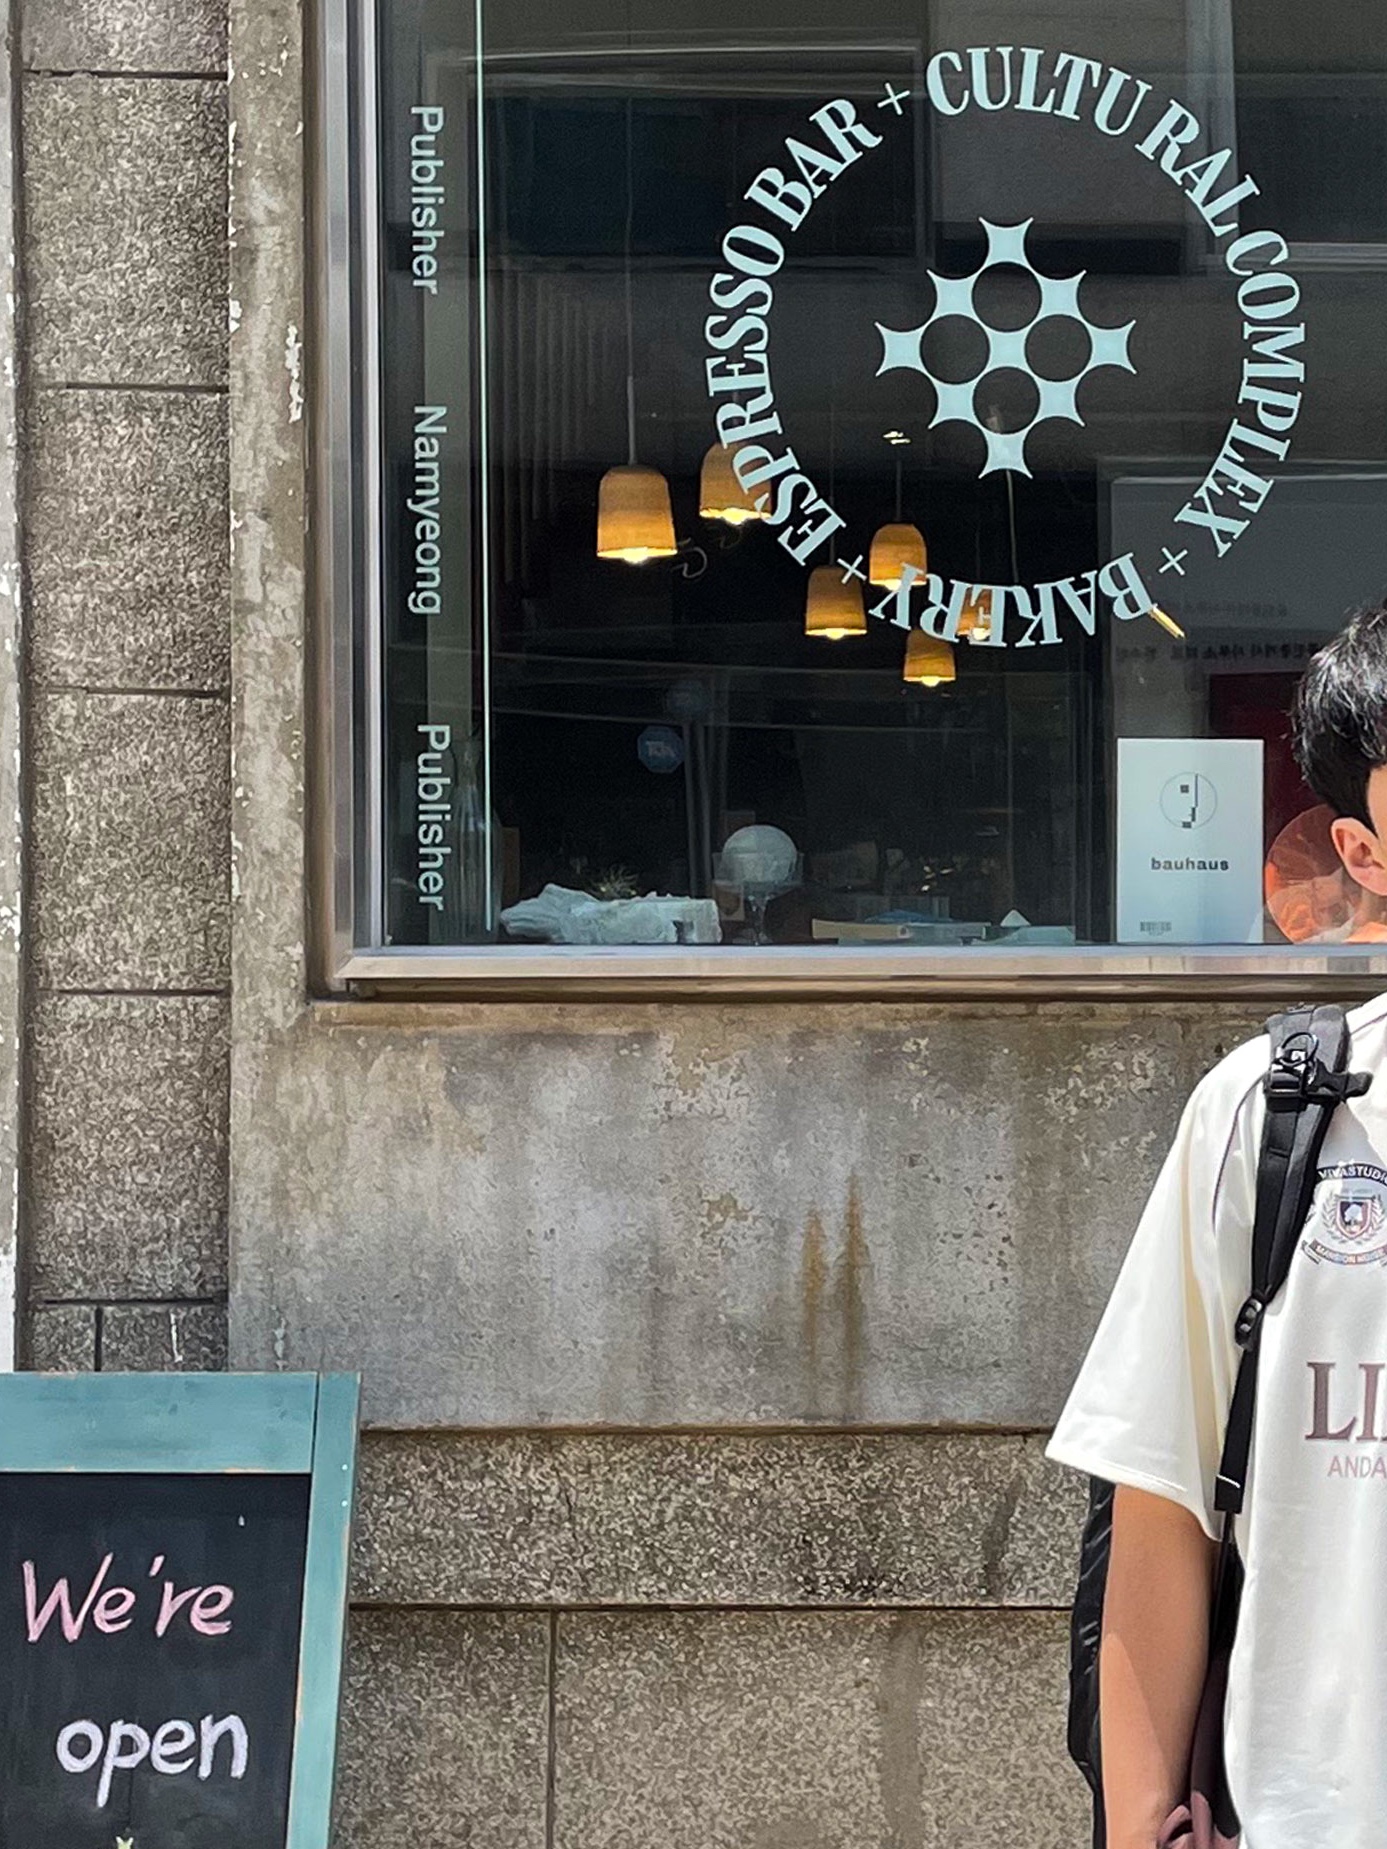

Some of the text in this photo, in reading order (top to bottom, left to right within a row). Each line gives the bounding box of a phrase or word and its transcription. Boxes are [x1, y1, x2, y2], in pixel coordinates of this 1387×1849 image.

[704, 97, 884, 567] ESPRESSO BAR
[925, 45, 1262, 238] CULTURAL
[1173, 229, 1307, 559] COMPLEX
[407, 105, 452, 912] Publisher Namyeong Publisher
[868, 552, 1159, 649] BAKERY
[1150, 856, 1230, 872] bauhaus
[22, 1552, 235, 1643] We're
[56, 1712, 249, 1807] open
